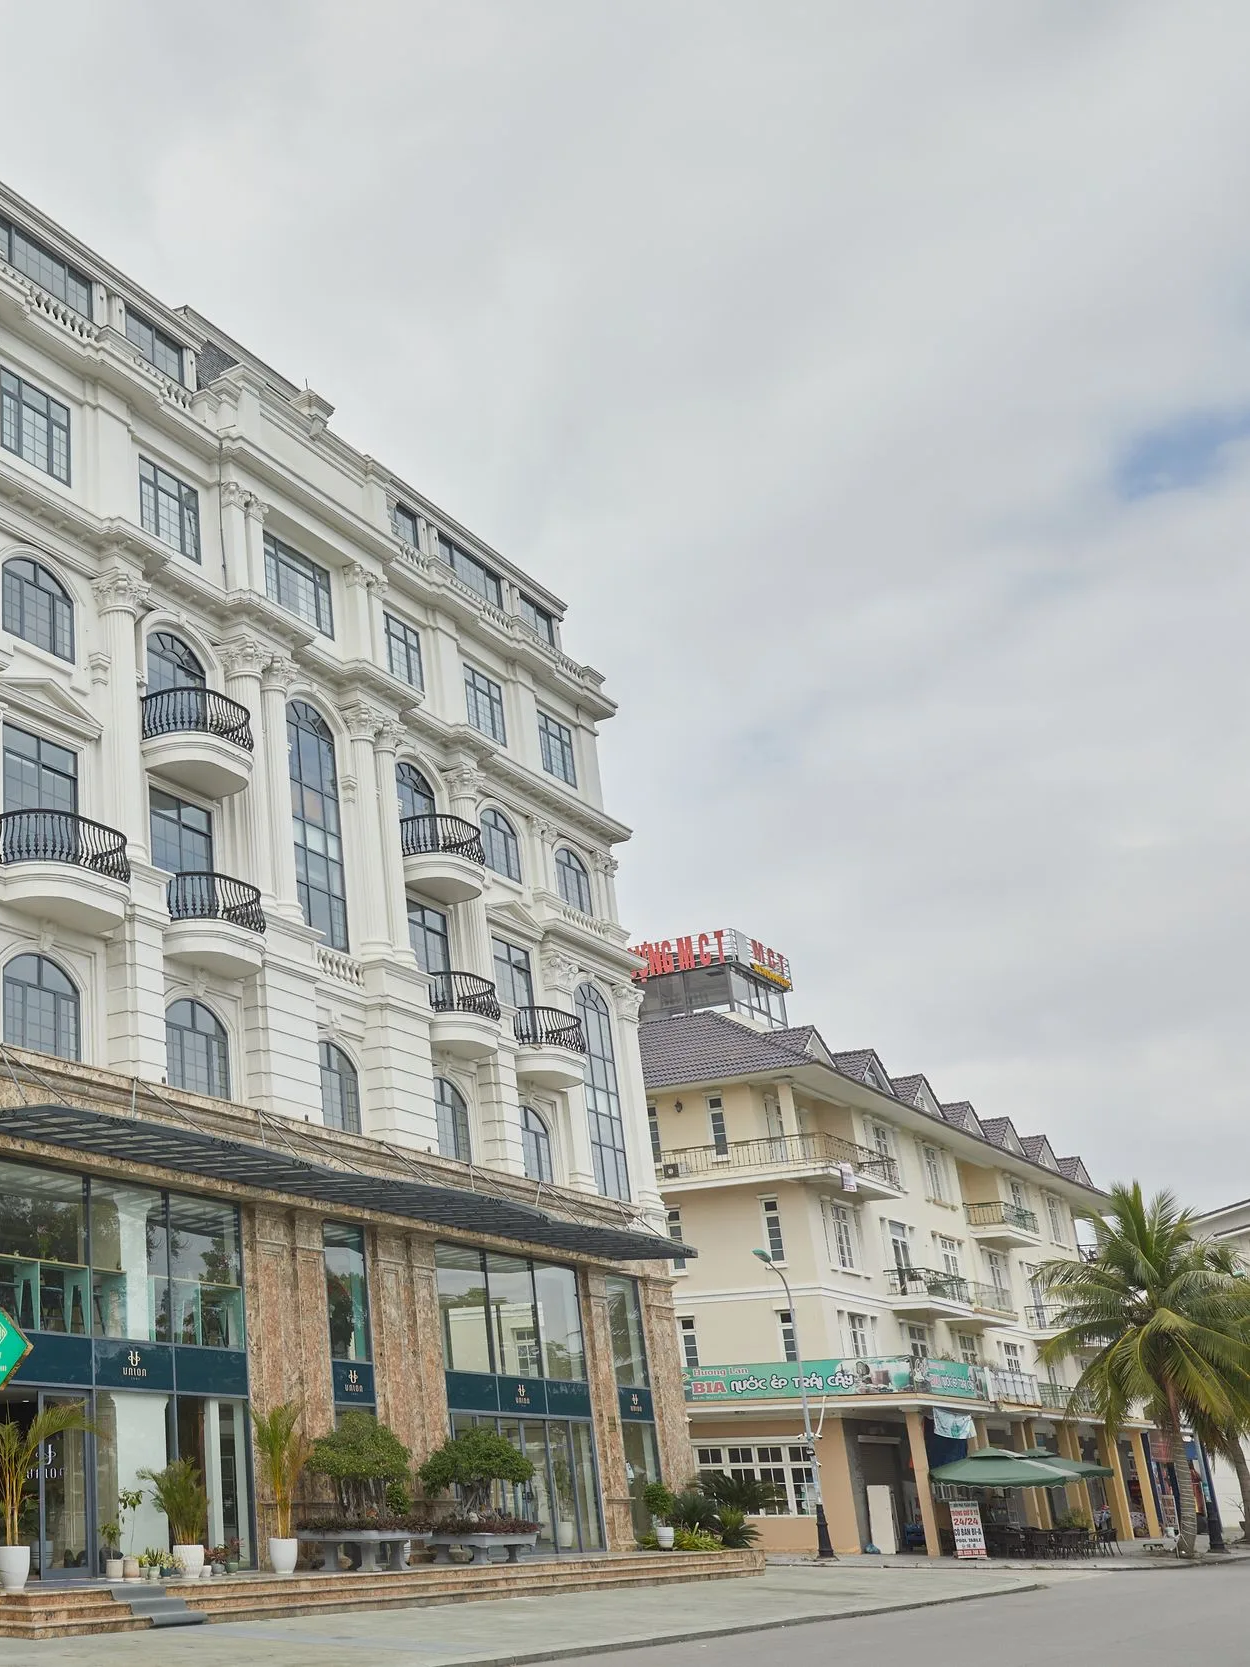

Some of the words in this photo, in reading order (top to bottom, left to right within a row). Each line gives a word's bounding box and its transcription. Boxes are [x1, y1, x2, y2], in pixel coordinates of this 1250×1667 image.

[123, 1367, 147, 1377] UNION
[692, 1381, 727, 1394] BIA
[953, 1517, 979, 1526] 24/24
